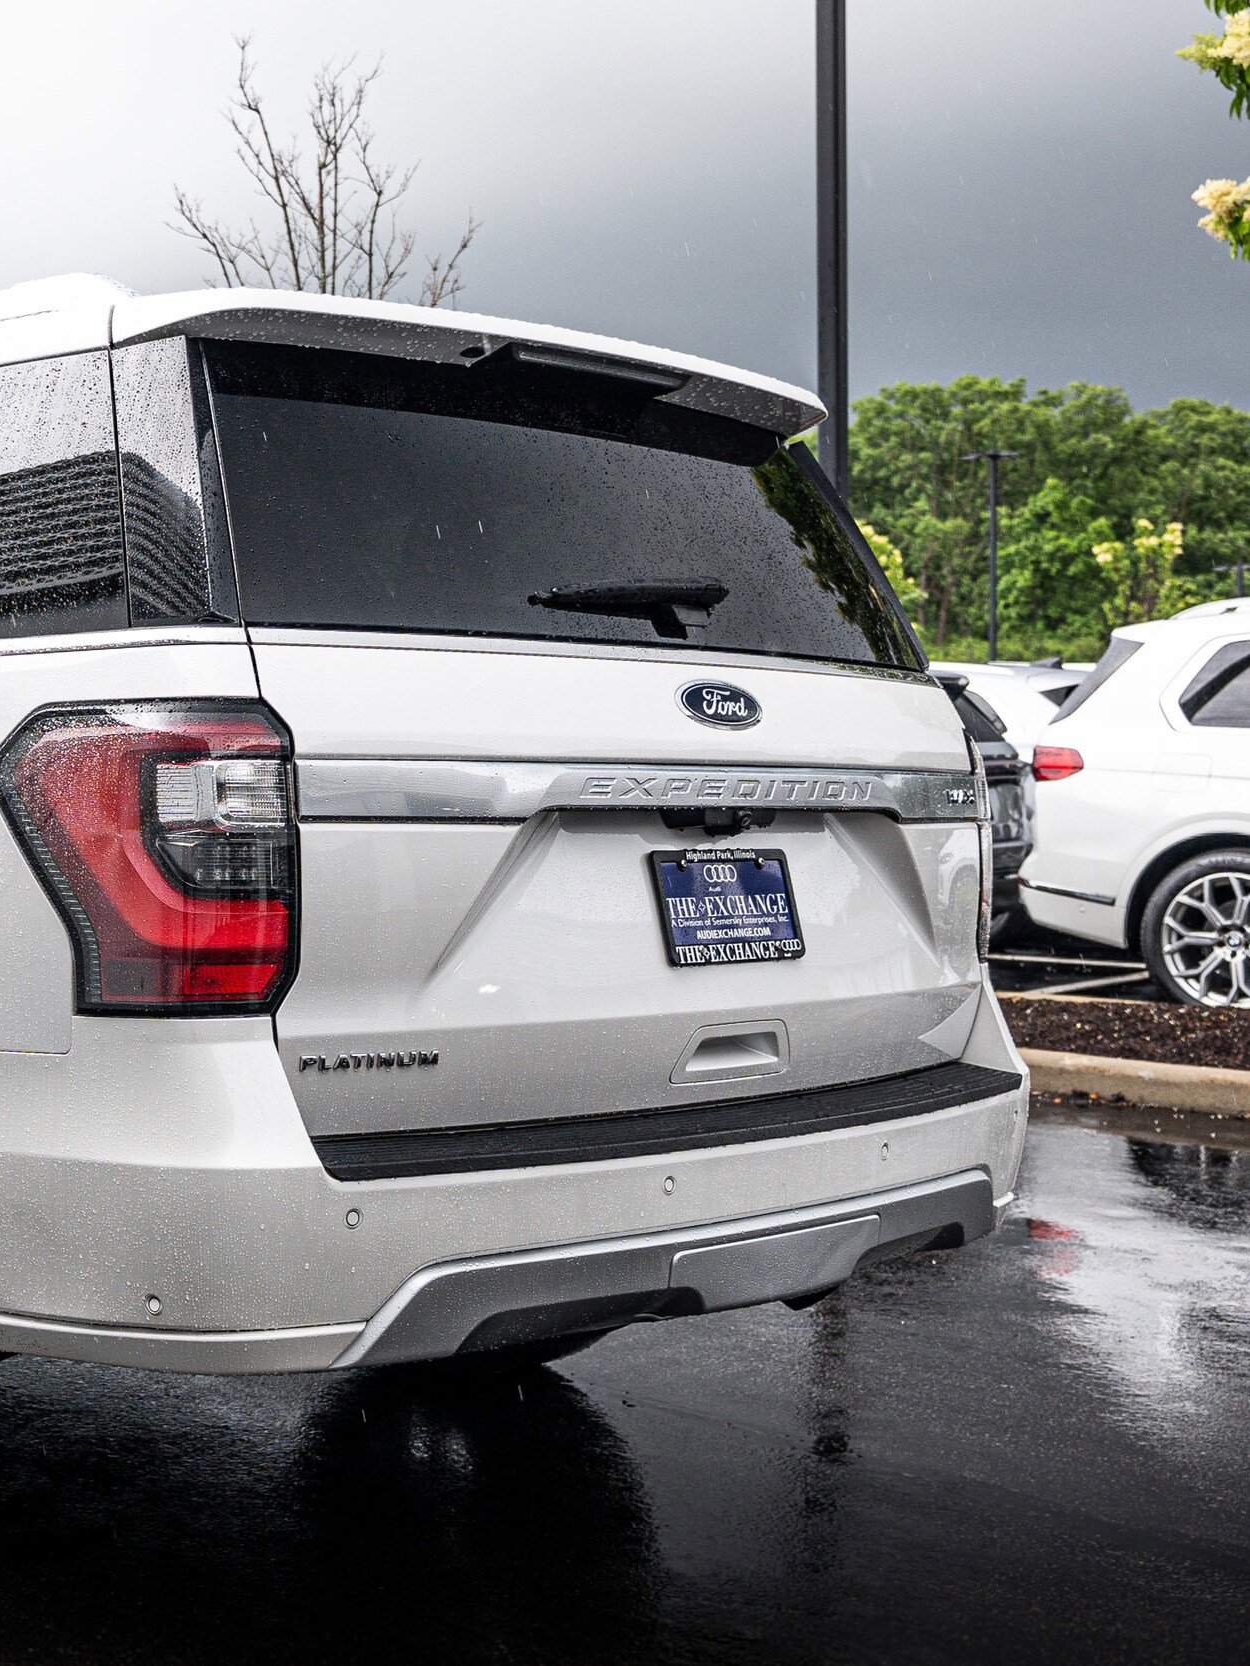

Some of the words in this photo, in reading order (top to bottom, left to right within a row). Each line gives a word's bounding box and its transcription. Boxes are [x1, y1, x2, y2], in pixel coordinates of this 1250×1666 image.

[702, 688, 748, 717] Ford
[579, 776, 872, 801] EXPEDITION
[686, 851, 715, 862] Highland
[716, 850, 734, 860] Park,
[734, 850, 756, 859] Illinois
[666, 897, 700, 918] THE
[704, 893, 789, 916] EXCHANGE
[672, 919, 678, 928] A
[677, 918, 704, 928] Division
[705, 918, 712, 926] of
[712, 916, 743, 926] Semersky
[777, 914, 790, 923] Inc.
[696, 927, 772, 940] AUDIEXCHANGE.COM
[676, 944, 706, 964] THE
[708, 940, 779, 963] EXCHANGE
[299, 1050, 440, 1073] PLATINUM
